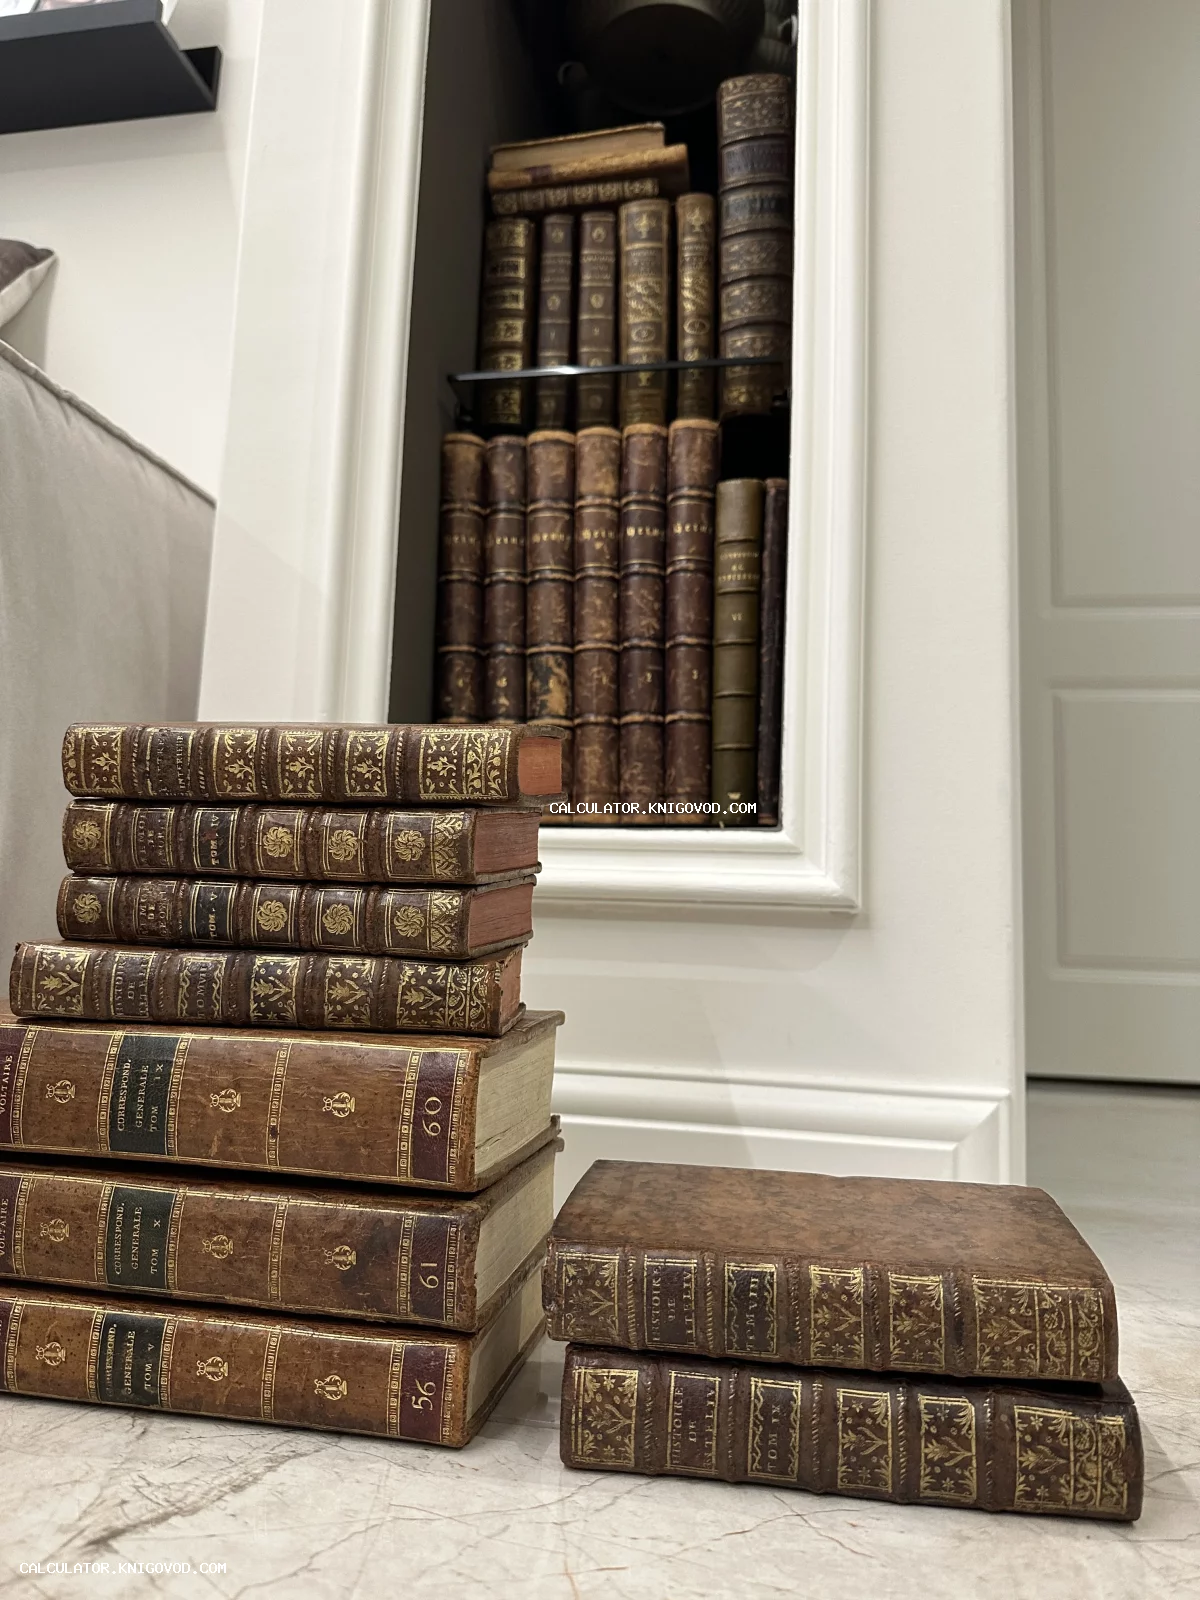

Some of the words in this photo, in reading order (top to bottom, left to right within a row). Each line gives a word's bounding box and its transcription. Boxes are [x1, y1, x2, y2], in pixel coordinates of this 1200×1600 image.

[128, 981, 136, 999] DE
[118, 1060, 132, 1131] CORRESPOND.
[135, 1065, 149, 1127] GENERALE
[149, 1105, 159, 1132] TOM
[422, 1096, 442, 1136] 60
[114, 1202, 125, 1275] CORRESPOND.
[131, 1206, 143, 1270] GENERALE
[153, 1219, 161, 1228] X
[150, 1248, 159, 1274] TOM
[418, 1262, 439, 1289] 61
[124, 1331, 136, 1395] GENERALE
[147, 1343, 155, 1352] V
[144, 1363, 153, 1390] TOM
[411, 1379, 437, 1411] 56
[672, 1387, 684, 1465] HISTOIRE
[767, 1433, 778, 1472] TOM
